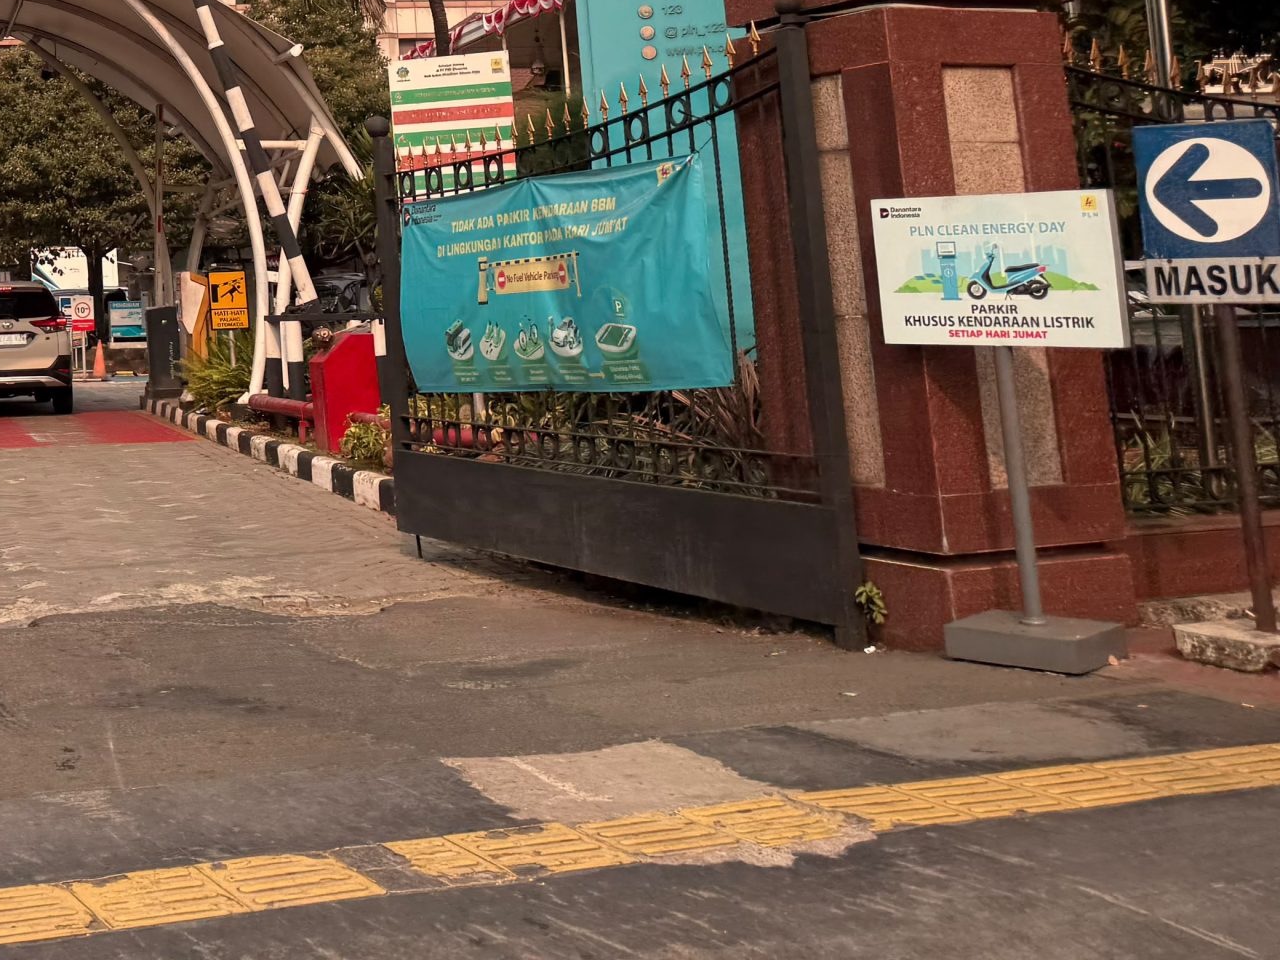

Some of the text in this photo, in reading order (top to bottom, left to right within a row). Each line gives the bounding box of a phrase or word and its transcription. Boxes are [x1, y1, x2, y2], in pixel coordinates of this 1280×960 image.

[661, 5, 683, 16] 123
[451, 218, 475, 234] TIDAK
[477, 215, 495, 230] ADA
[533, 200, 589, 221] KENDARAAN
[591, 197, 616, 212] BBM
[910, 221, 1066, 237] PLN CLEAN ENERGY DAY
[437, 245, 445, 258] DI
[503, 231, 544, 248] KANTOR
[1154, 263, 1280, 296] MASUK
[971, 304, 1018, 314] PARKIR
[904, 315, 1095, 329] KHUSUS KENDARAAN LISTRIK
[948, 329, 1048, 339] SETIAP HARI JUMAT
